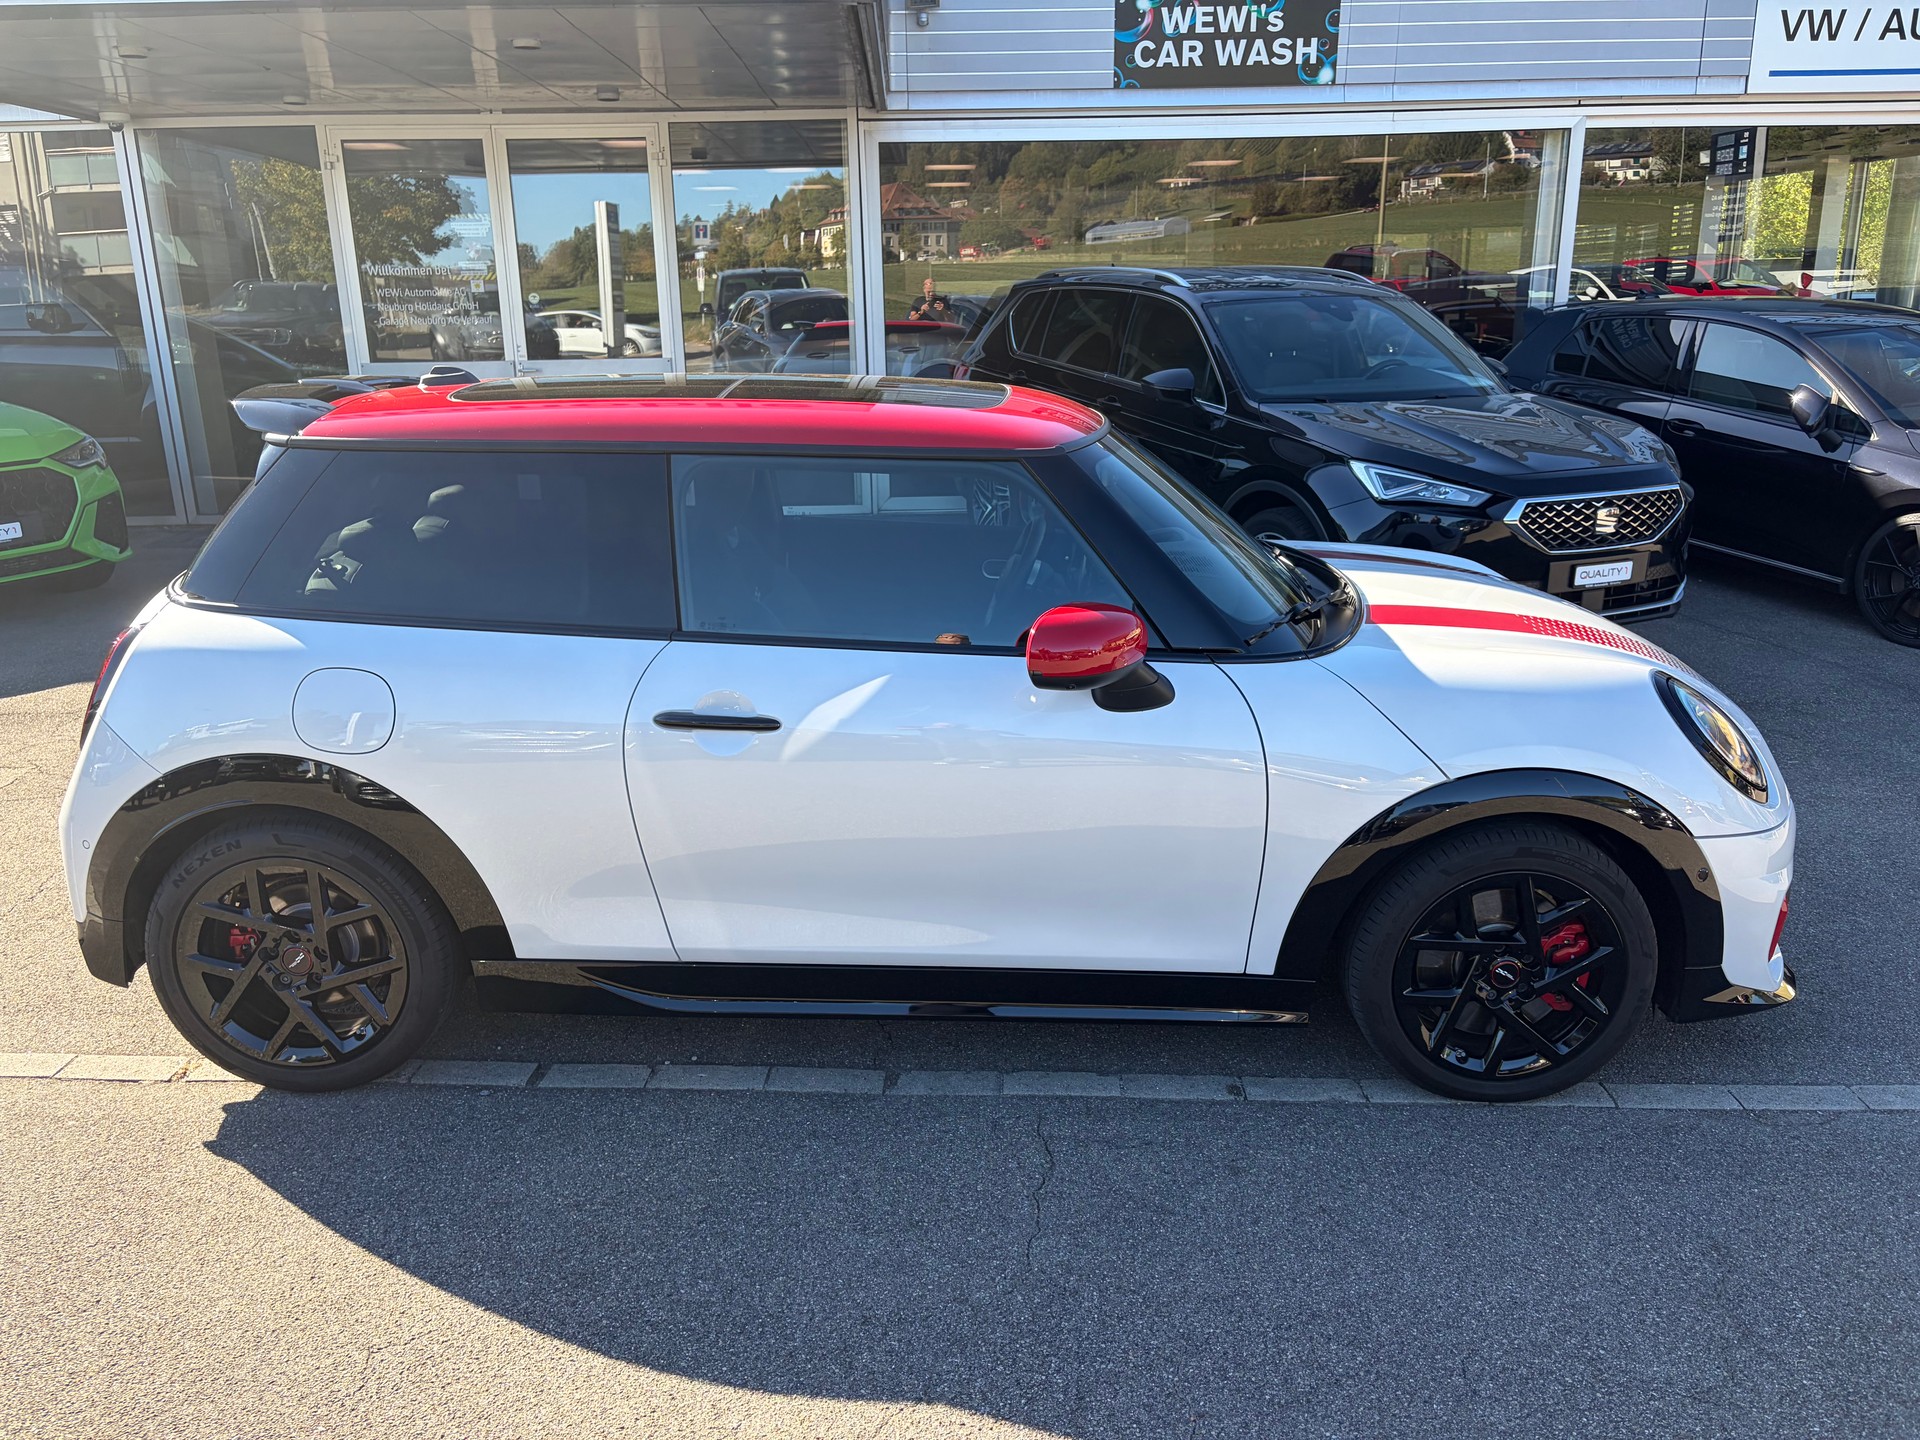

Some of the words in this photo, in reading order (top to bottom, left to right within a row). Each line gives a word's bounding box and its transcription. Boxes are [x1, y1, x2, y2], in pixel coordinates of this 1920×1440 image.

[1161, 4, 1285, 34] WEWi's
[1781, 8, 1847, 42] VW
[1134, 39, 1204, 68] CAR
[1214, 37, 1318, 67] WASH
[366, 264, 433, 277] Willkommen
[435, 264, 451, 276] bei
[375, 287, 403, 297] WEWi
[454, 286, 467, 297] AG
[377, 302, 414, 314] Neuburg
[452, 301, 479, 311] GmbH
[378, 316, 409, 328] Garage
[410, 315, 447, 327] Neuburg
[448, 315, 461, 325] AG
[1579, 566, 1624, 580] QUALITY
[171, 838, 243, 889] NEXEN
